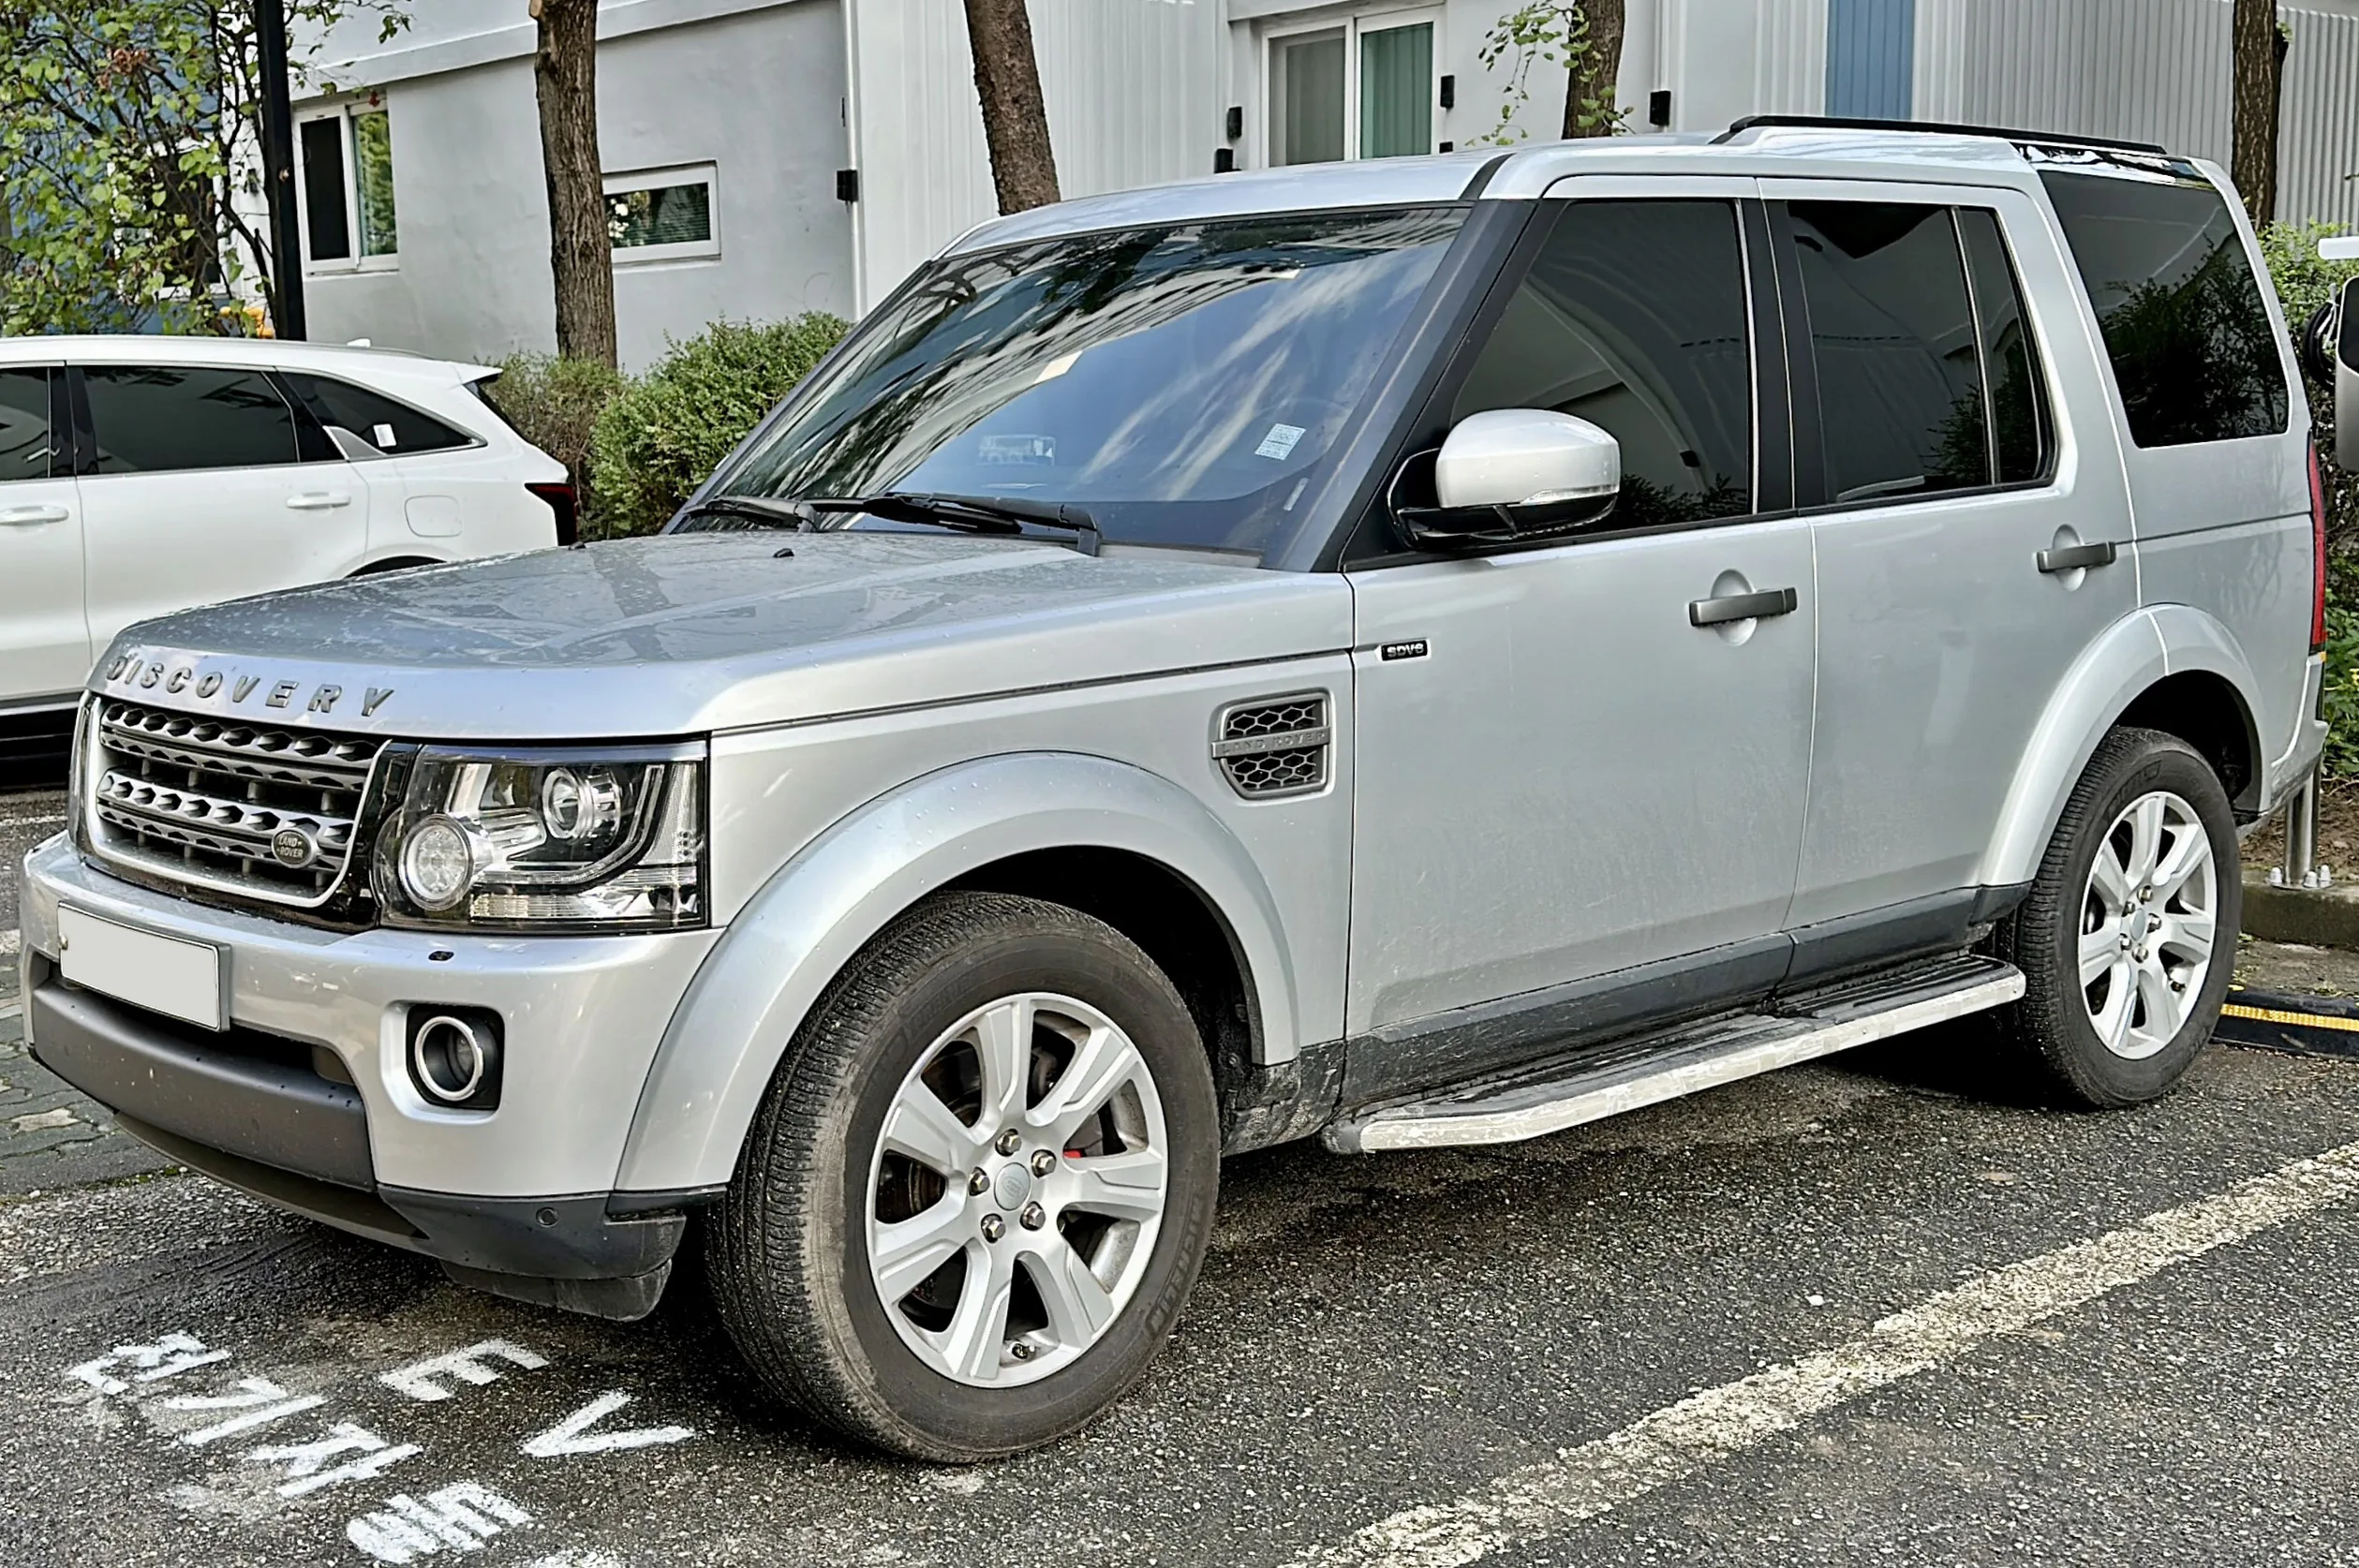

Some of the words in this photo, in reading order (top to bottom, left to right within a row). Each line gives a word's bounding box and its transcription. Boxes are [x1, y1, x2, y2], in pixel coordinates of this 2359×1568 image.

[106, 656, 394, 717] DISCOVERY
[1221, 738, 1266, 756] LAND
[278, 835, 298, 848] LAND
[280, 846, 304, 859] ROVER
[1150, 1192, 1200, 1334] MICHELIN
[66, 1330, 656, 1568] 전기자동
